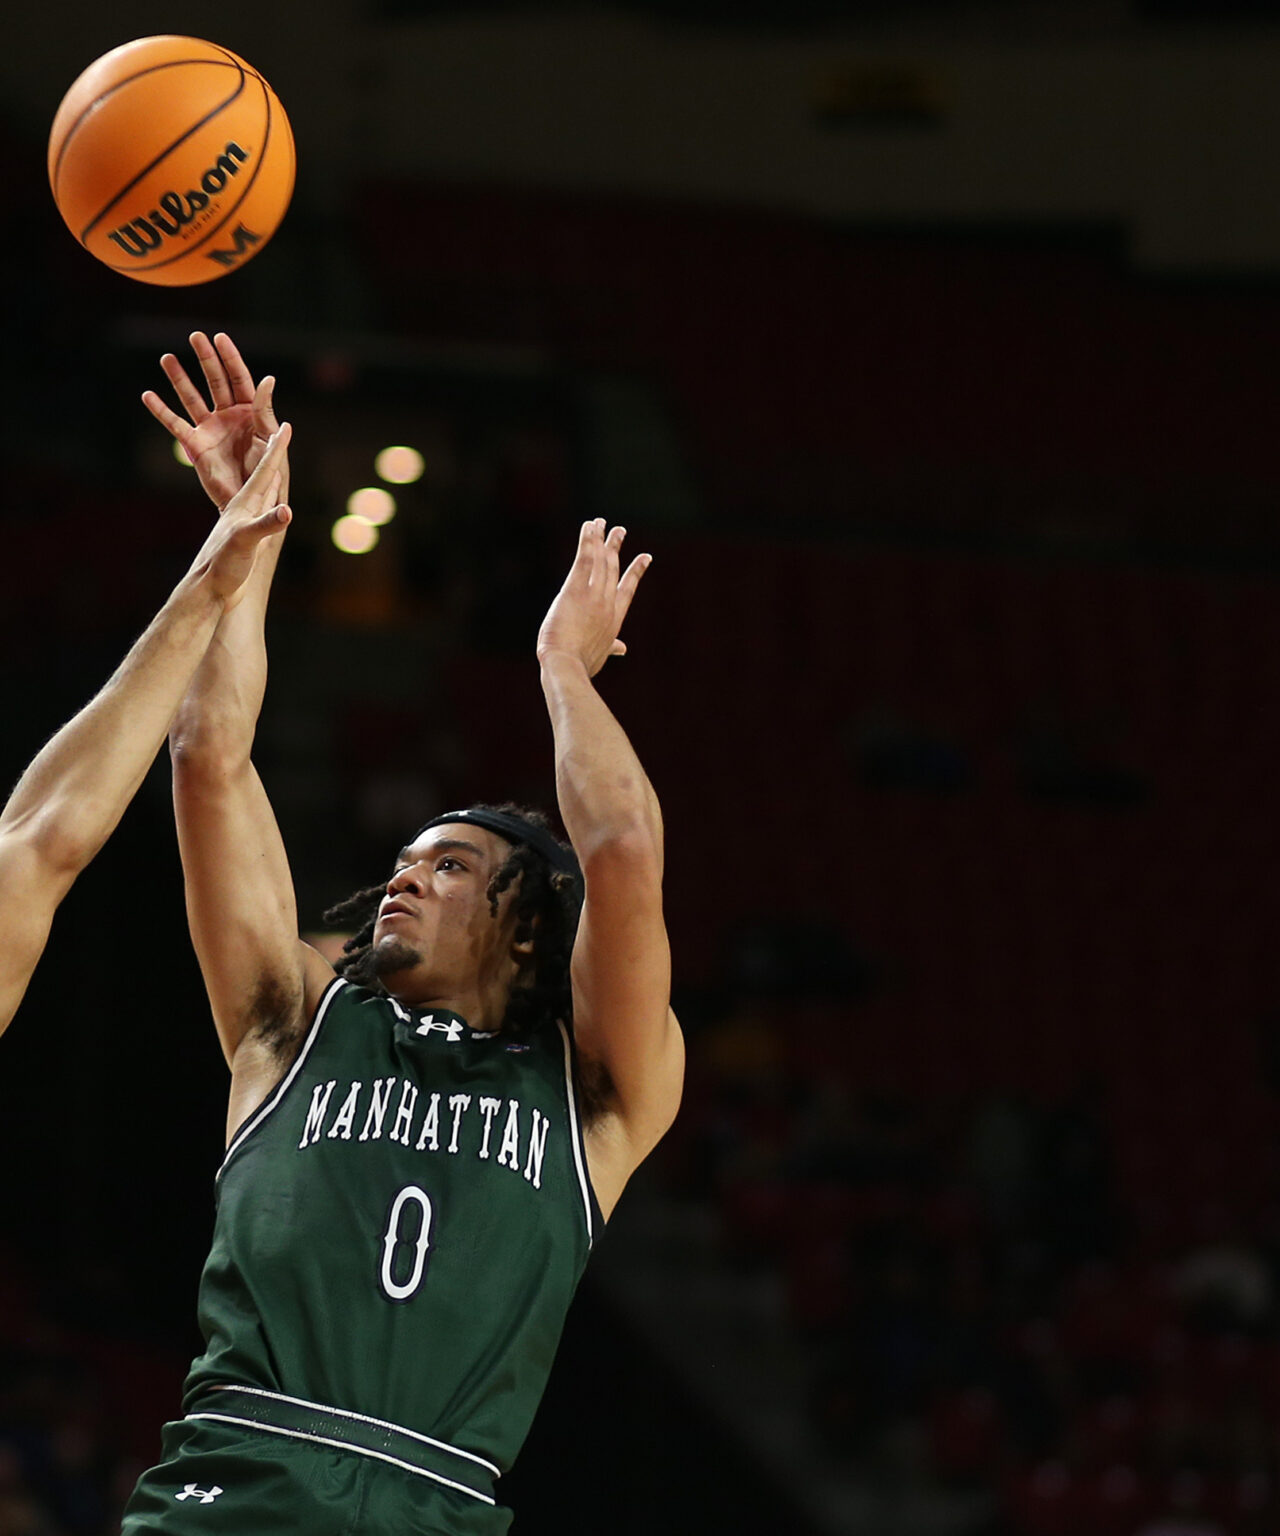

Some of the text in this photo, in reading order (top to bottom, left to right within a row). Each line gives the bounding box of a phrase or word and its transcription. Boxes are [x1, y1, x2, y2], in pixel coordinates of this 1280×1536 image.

[108, 140, 248, 257] Wilson
[206, 221, 262, 267] M
[298, 1077, 549, 1189] MANHATTAN
[379, 1184, 433, 1301] 0
